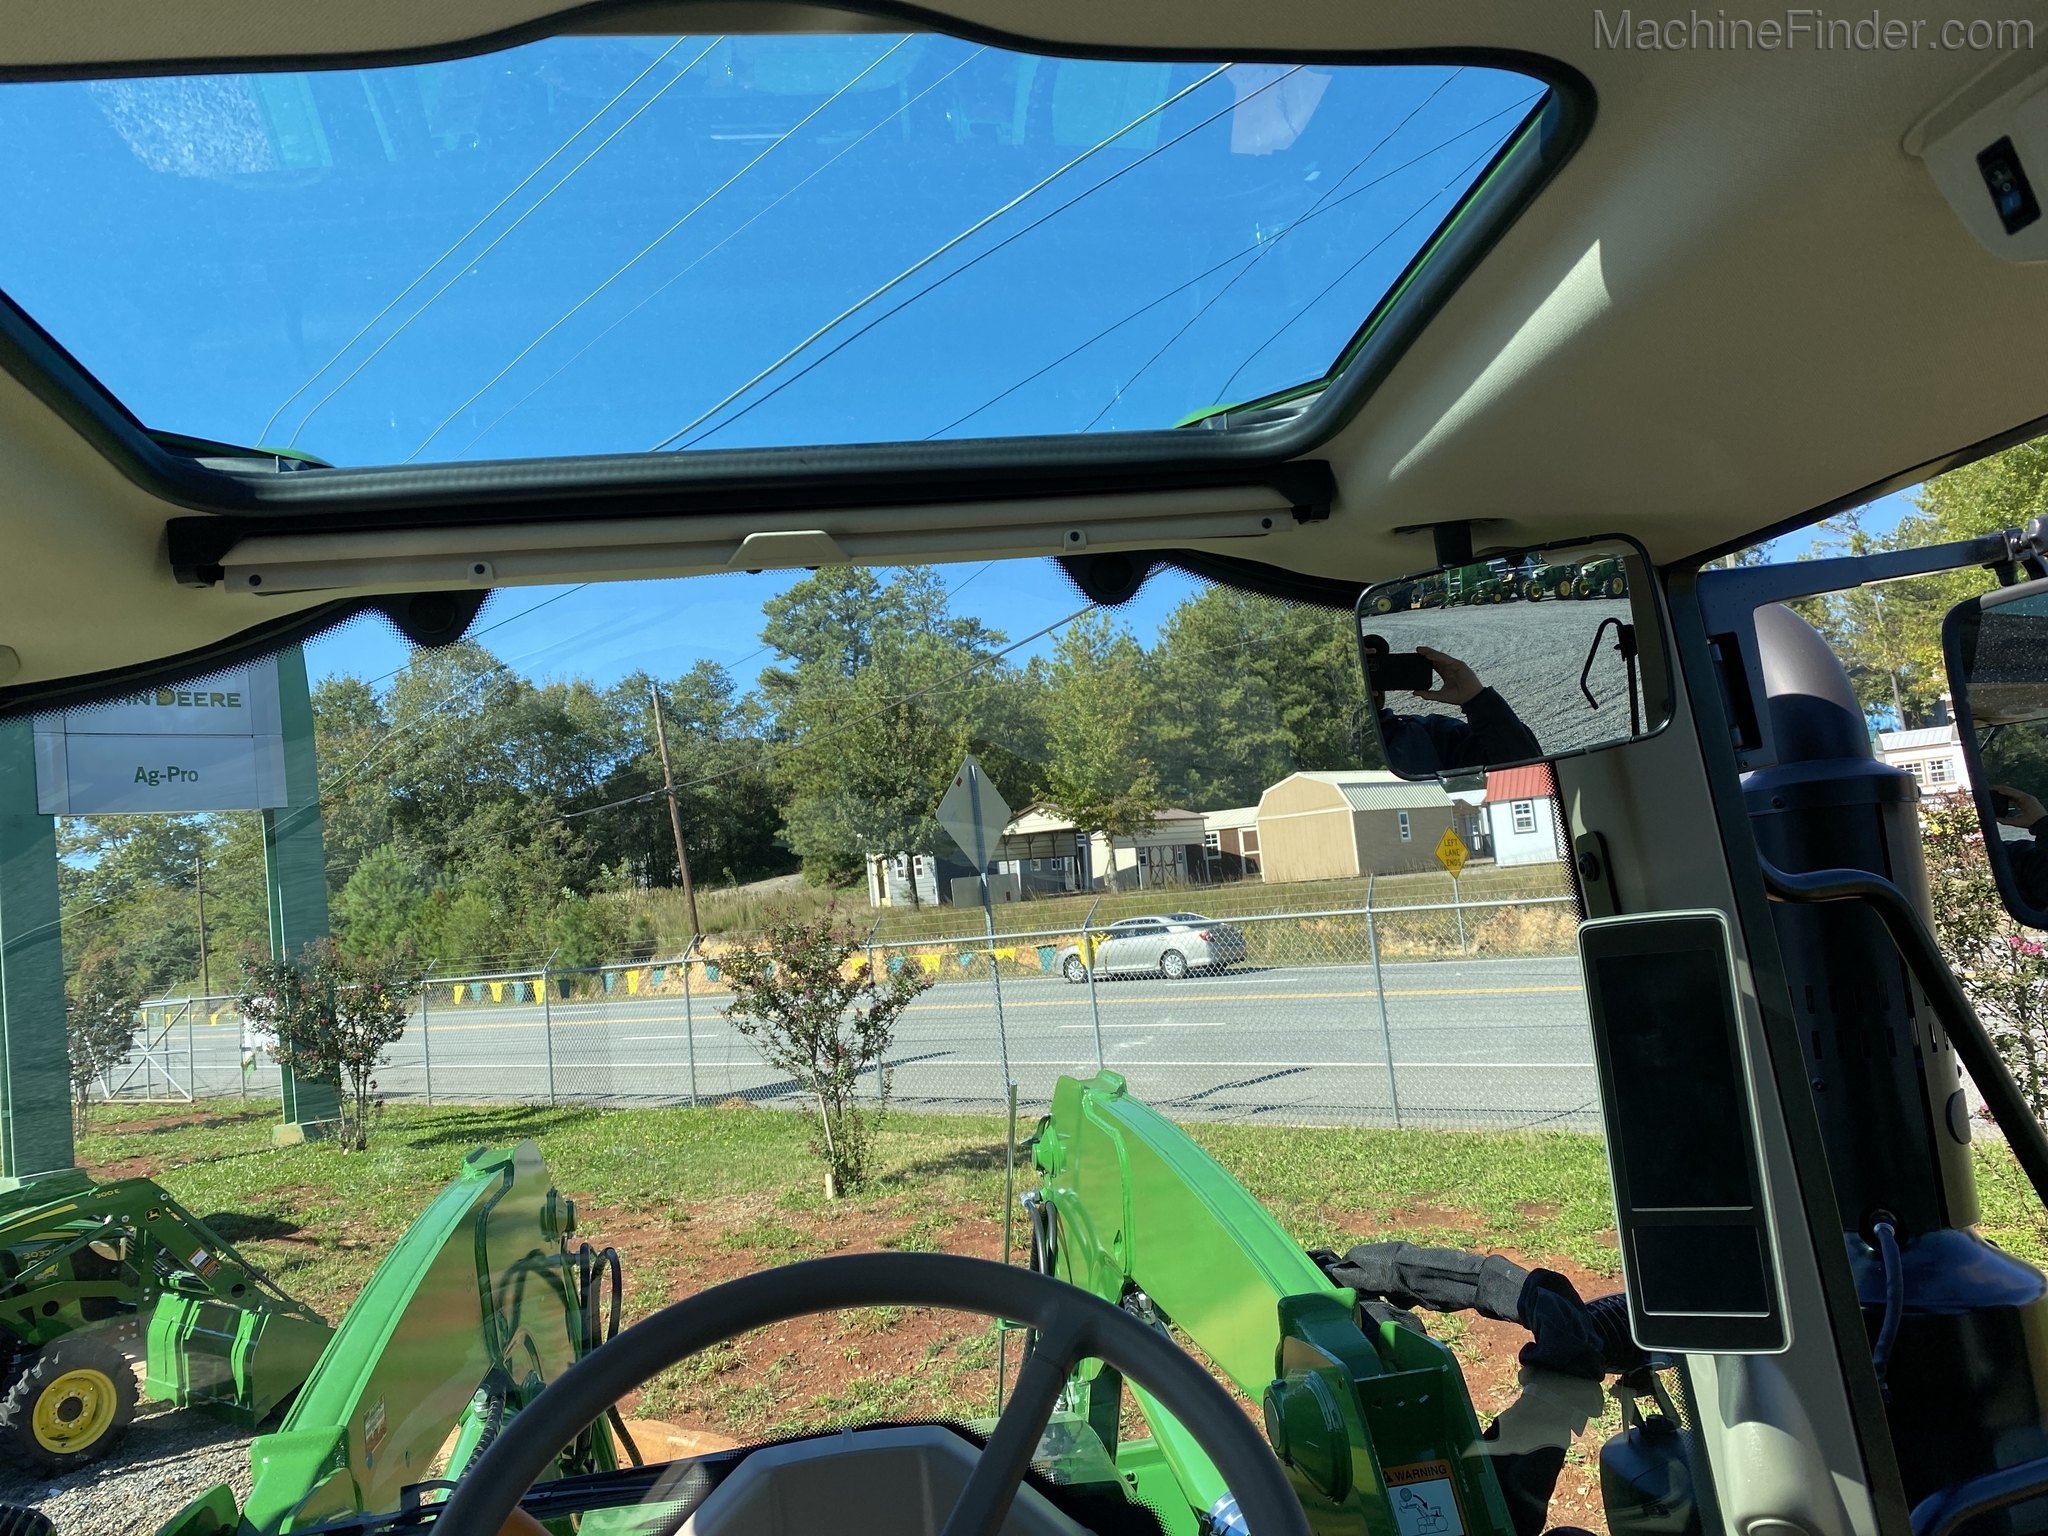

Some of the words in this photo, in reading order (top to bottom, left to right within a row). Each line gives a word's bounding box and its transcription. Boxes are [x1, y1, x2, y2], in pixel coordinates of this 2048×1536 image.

[156, 689, 242, 708] DEERE
[134, 766, 199, 787] Ag-Pro
[1444, 838, 1458, 846] LEFT
[1445, 848, 1460, 857] LANE
[1446, 858, 1461, 867] ENDS
[1394, 1464, 1447, 1481] WARNING
